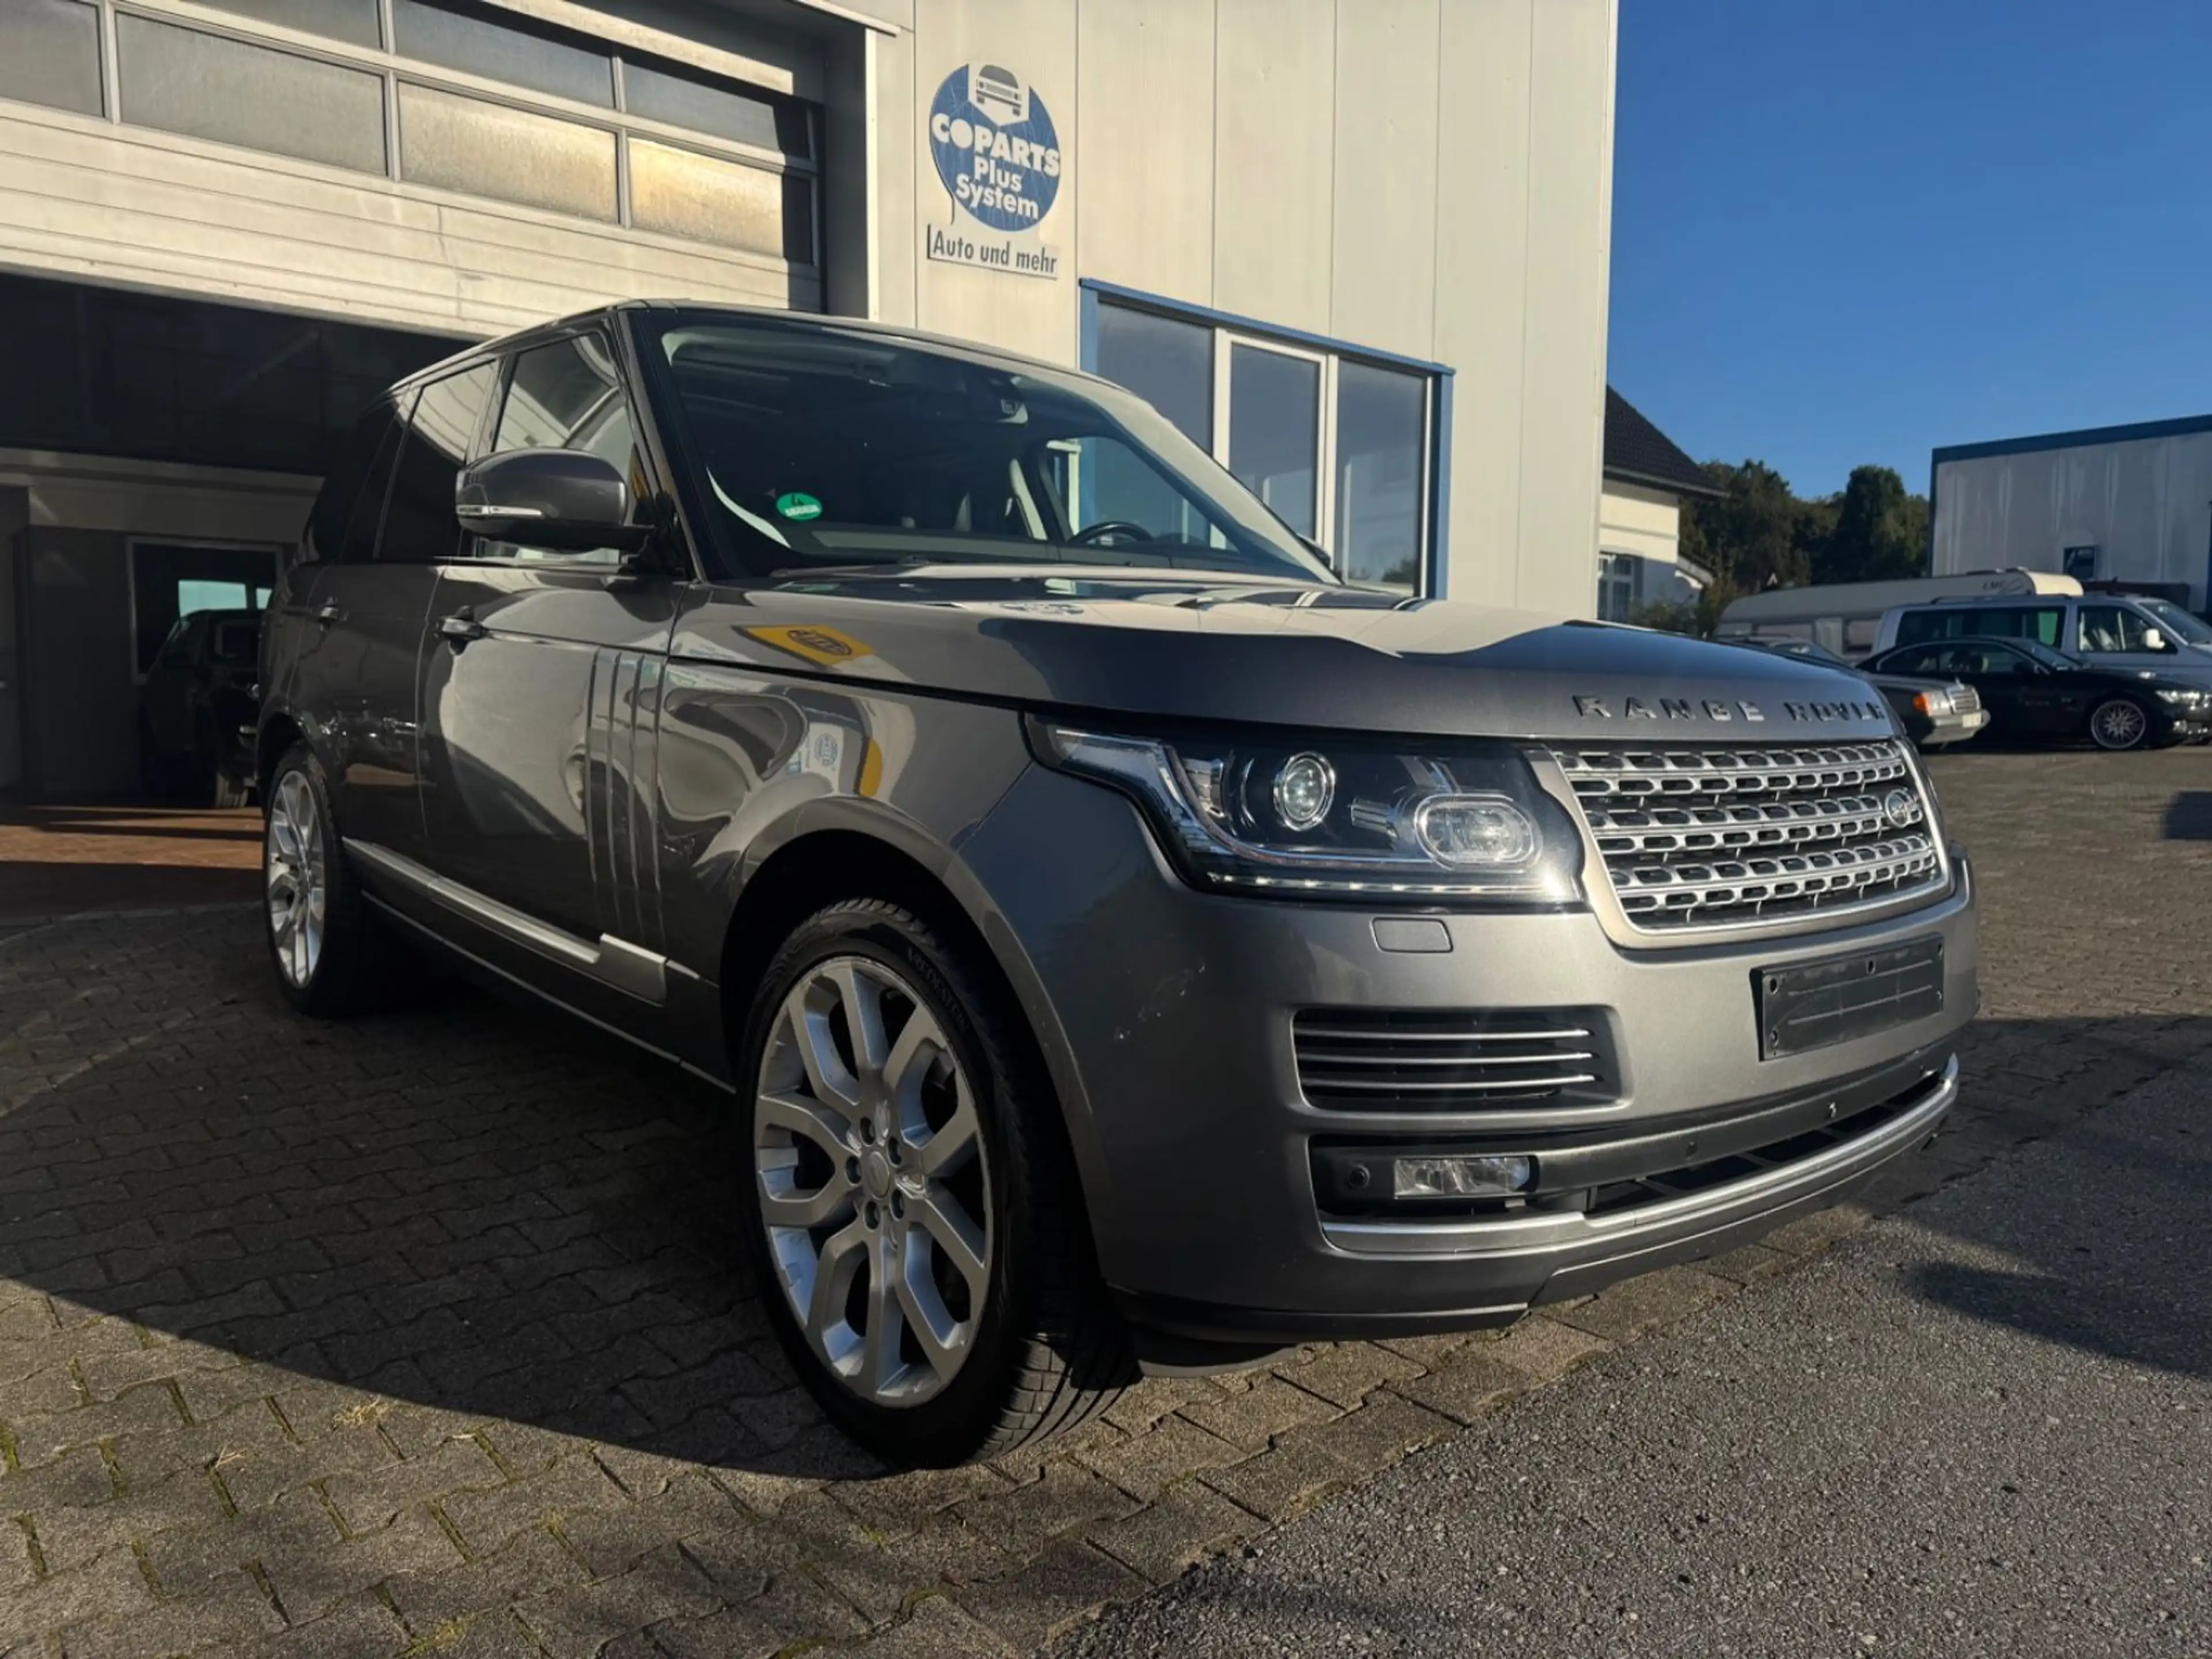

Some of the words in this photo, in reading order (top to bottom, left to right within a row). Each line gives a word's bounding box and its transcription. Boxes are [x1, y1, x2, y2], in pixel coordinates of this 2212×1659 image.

[931, 112, 1060, 177] COPARTS
[955, 173, 1039, 219] System
[974, 156, 1022, 192] Plus
[933, 230, 975, 259] Auto
[980, 241, 1010, 266] und
[1016, 247, 1058, 274] mehr
[1573, 695, 1765, 722] RANGE
